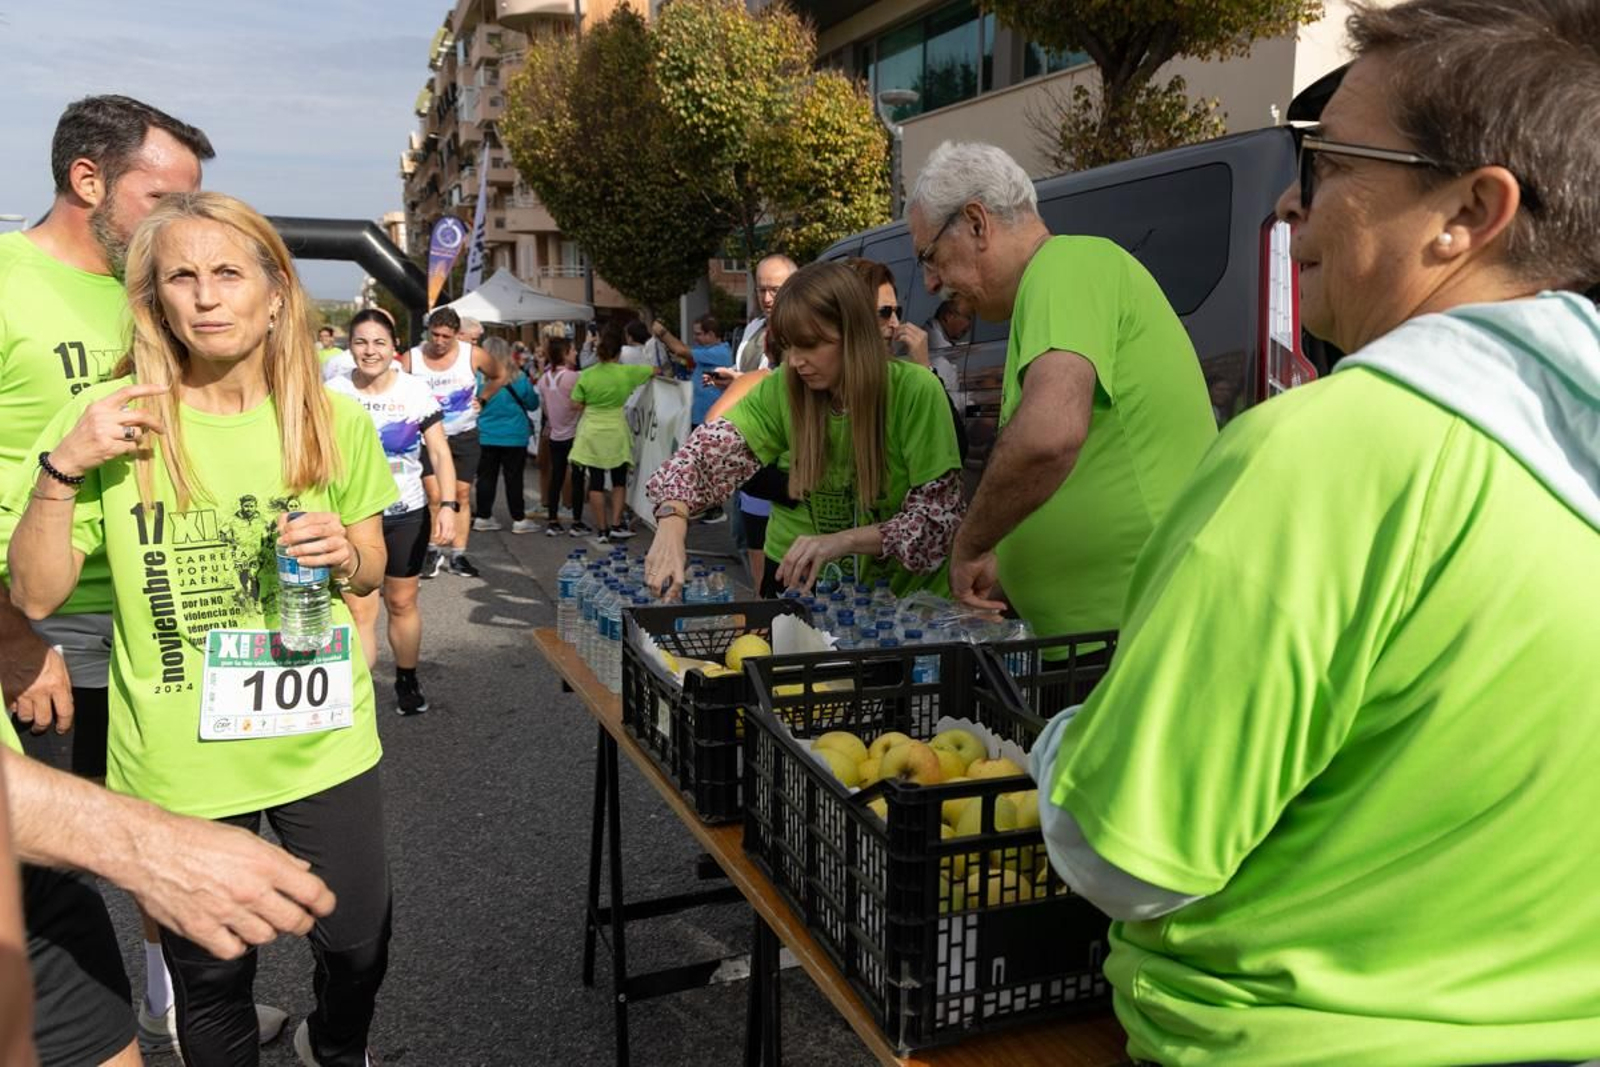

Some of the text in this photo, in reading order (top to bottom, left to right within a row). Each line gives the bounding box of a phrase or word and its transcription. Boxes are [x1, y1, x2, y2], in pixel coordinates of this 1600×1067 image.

[53, 341, 88, 379] 17
[130, 501, 164, 545] 17
[169, 509, 219, 544] XI
[175, 551, 248, 565] CARRERA
[178, 574, 219, 588] JAÉN
[182, 600, 198, 610] por
[199, 597, 209, 607] la
[143, 550, 185, 684] noviembre
[183, 606, 241, 622] violencia de
[228, 618, 239, 629] la
[218, 634, 251, 659] XI
[154, 683, 194, 694] 2024
[243, 666, 329, 712] 100
